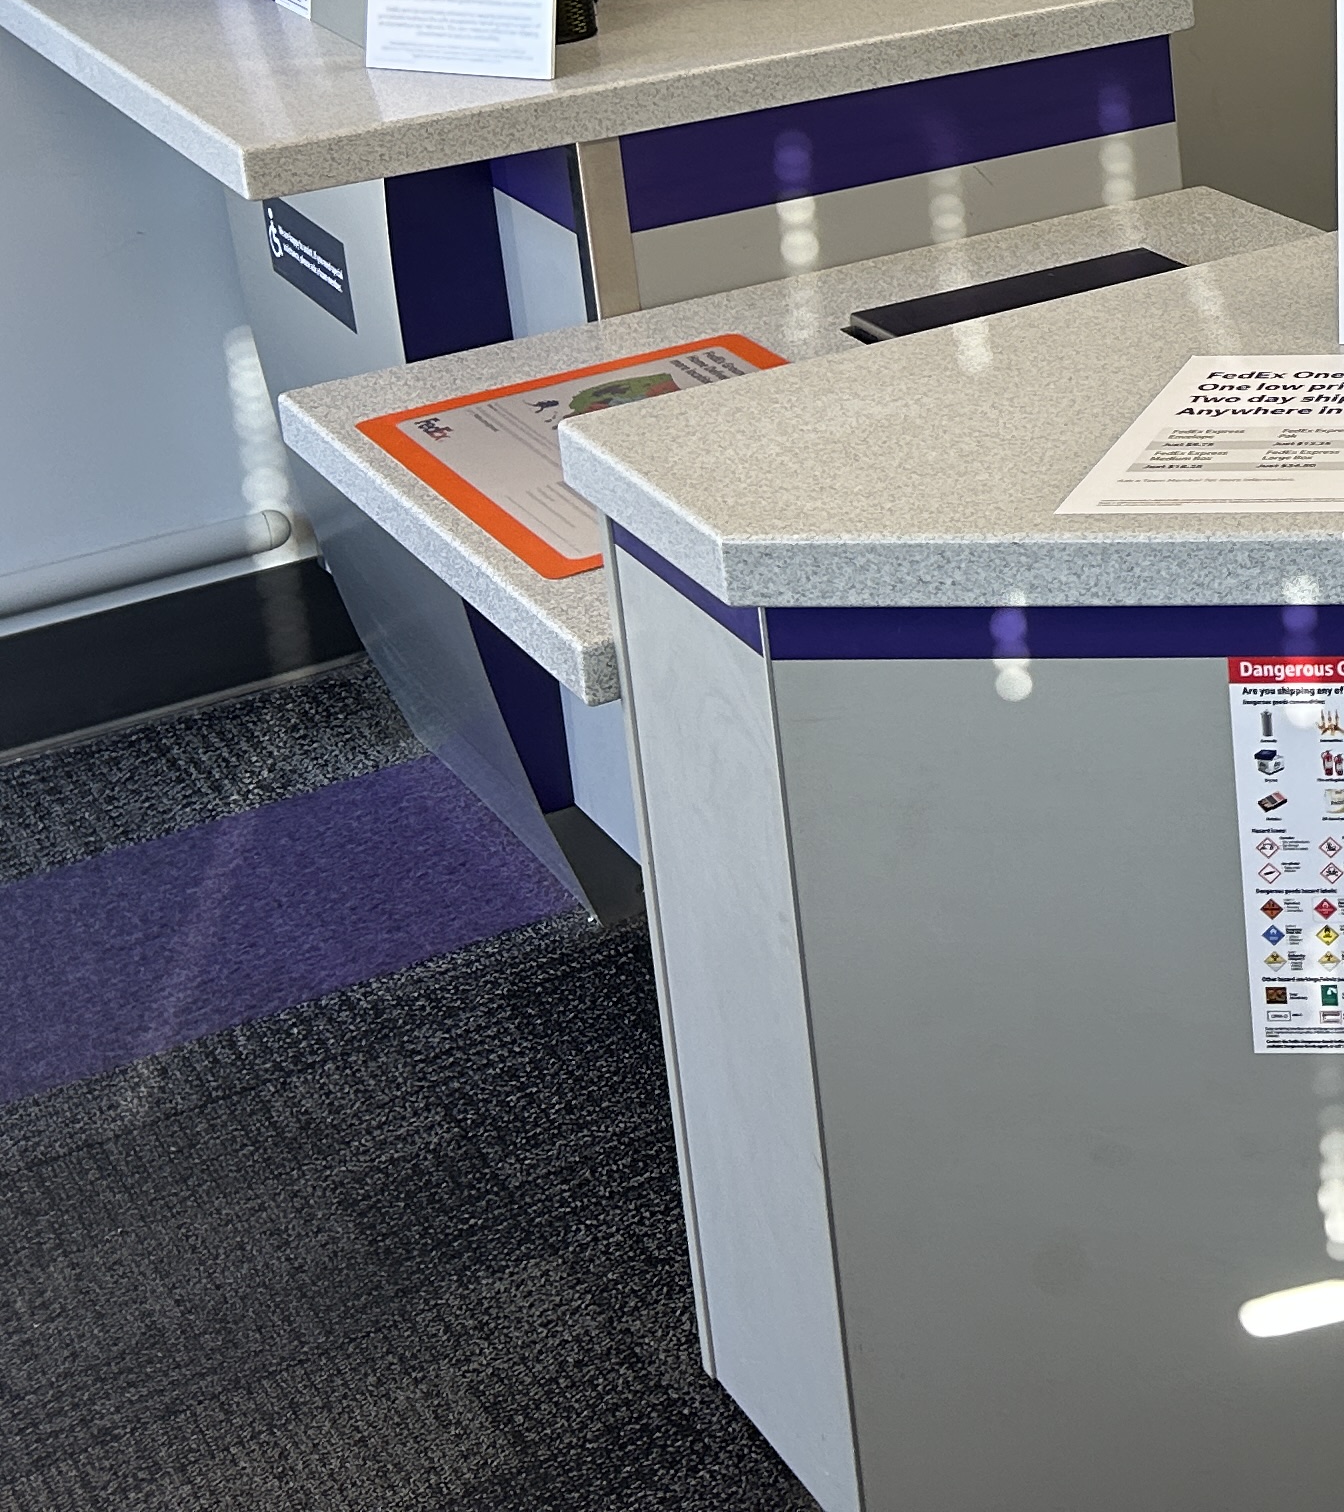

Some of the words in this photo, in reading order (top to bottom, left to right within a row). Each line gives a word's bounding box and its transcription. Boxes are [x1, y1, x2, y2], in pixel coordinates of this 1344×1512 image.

[1206, 371, 1288, 380] FedEx
[1256, 383, 1305, 391] low
[1247, 395, 1297, 405] day
[1175, 407, 1313, 417] Anywhere
[1318, 406, 1344, 415] in
[1240, 662, 1333, 680] Dangerous
[1242, 687, 1258, 695] Are
[1259, 688, 1275, 697] you
[1277, 687, 1315, 697] shipping
[1317, 688, 1332, 697] any
